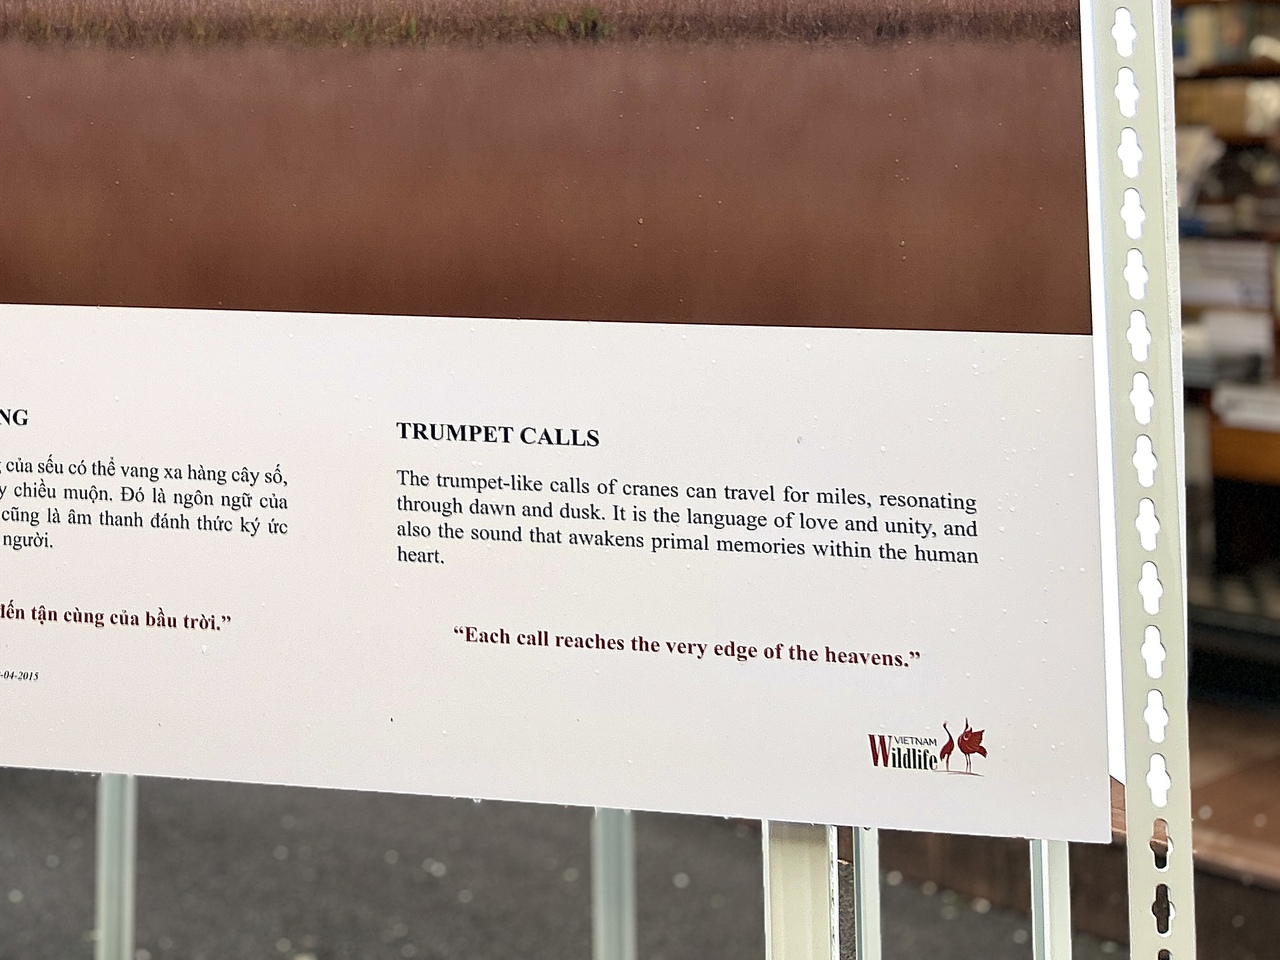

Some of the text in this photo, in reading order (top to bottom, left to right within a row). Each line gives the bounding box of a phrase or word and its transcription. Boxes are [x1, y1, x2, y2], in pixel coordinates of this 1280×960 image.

[396, 422, 600, 447] TRUMPET CALLS
[6, 457, 33, 473] của
[37, 454, 64, 474] sếu
[68, 459, 87, 475] có
[91, 456, 116, 477] thể
[120, 466, 159, 483] vang
[164, 468, 183, 480] xa
[187, 464, 227, 486] hàng
[231, 466, 260, 487] cây
[264, 463, 288, 487] số,
[14, 478, 56, 499] chiều
[63, 485, 113, 504] muộn.
[120, 486, 145, 503] Đó
[152, 487, 166, 504] là
[173, 489, 214, 509] ngôn
[221, 492, 253, 511] ngữ
[259, 493, 288, 509] của
[396, 470, 977, 515] The trumpet-like calls of cranes can travel for miles, resonating
[1, 506, 40, 527] cũng
[47, 507, 61, 524] là
[68, 509, 92, 525] âm
[99, 510, 143, 528] thanh
[150, 512, 190, 530] đánh
[197, 515, 233, 532] thức
[240, 516, 260, 537] ký
[268, 518, 288, 534] ức
[397, 495, 978, 539] through dawn and dusk. It is the language of love and unity, and
[3, 532, 53, 551] người.
[397, 520, 979, 564] also the sound that awakens primal memories within the human
[397, 545, 444, 564] heart.
[31, 605, 58, 625] tận
[63, 607, 105, 628] cùng
[110, 609, 139, 626] của
[146, 607, 177, 628] bầu
[183, 614, 231, 631] trời.”
[454, 626, 920, 667] “Each call reaches the very edge of the heavens.”
[868, 733, 938, 771] Wildlife
[894, 736, 937, 747] VIETNAM
